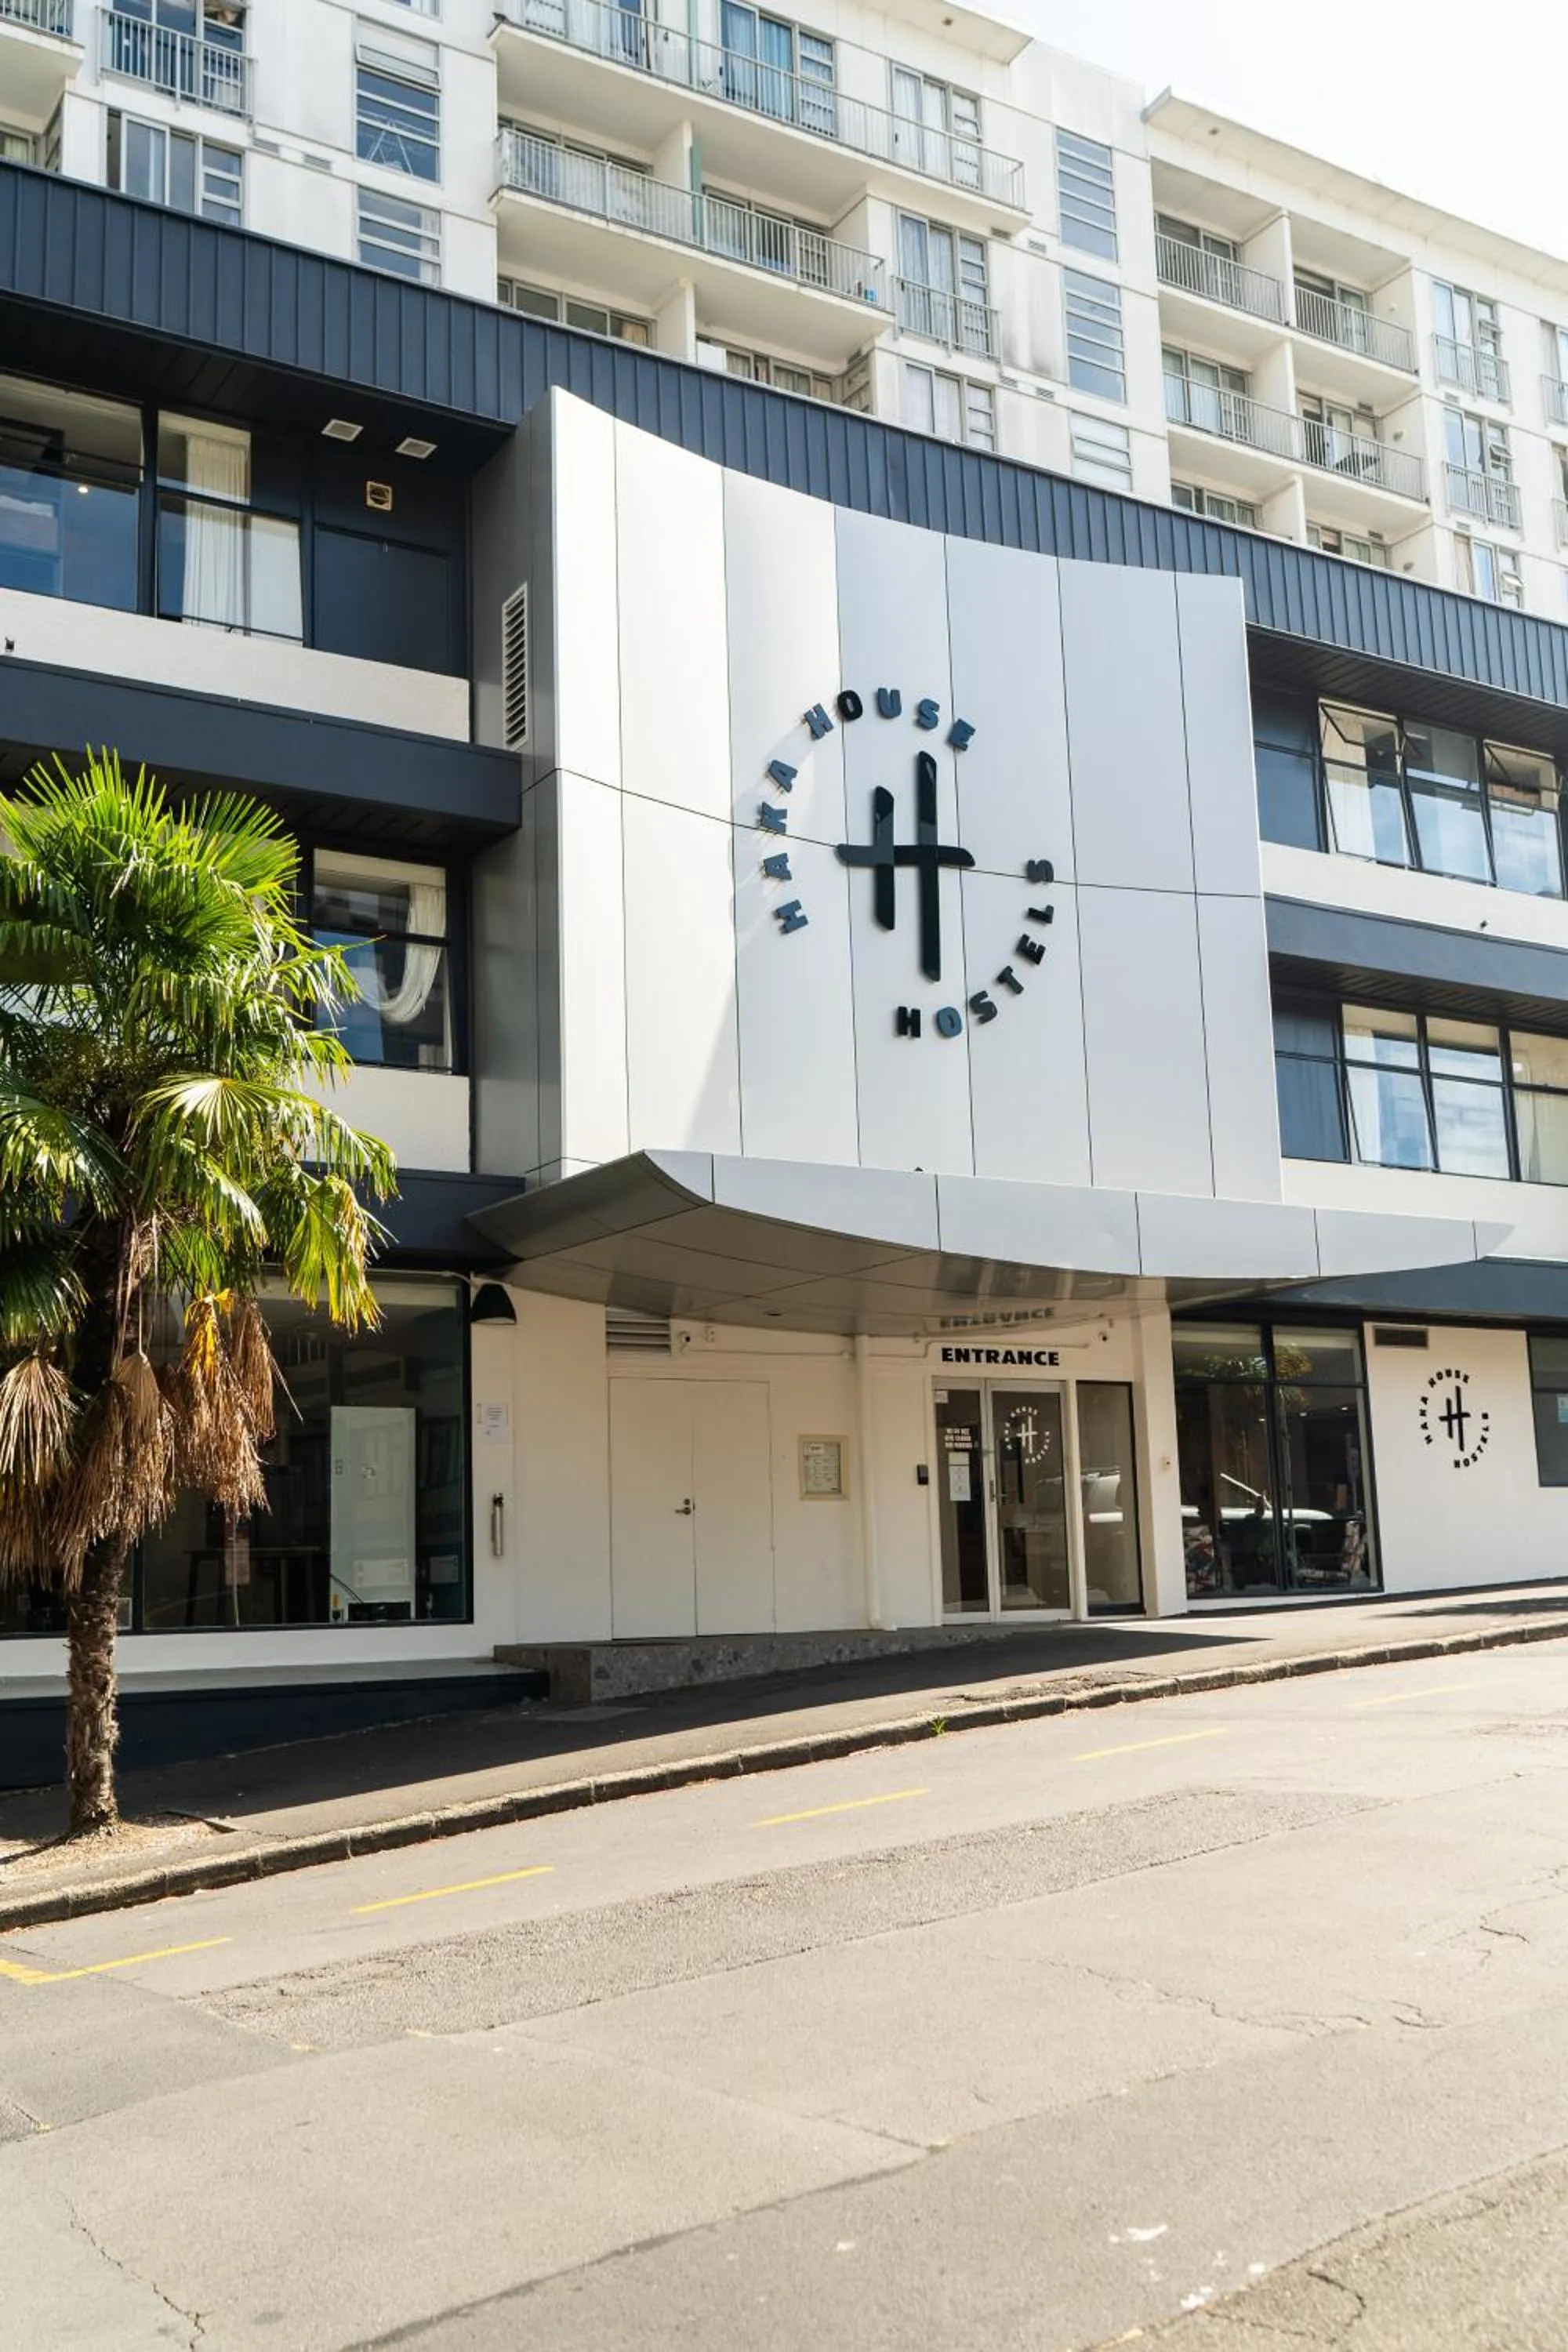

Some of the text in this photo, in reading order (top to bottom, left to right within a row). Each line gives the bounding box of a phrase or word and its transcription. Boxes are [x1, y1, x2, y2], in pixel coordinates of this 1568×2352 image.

[757, 688, 976, 935] HAKA HOUSE
[896, 858, 1054, 1038] HOSTELS
[942, 1348, 1059, 1366] ENTRANCE
